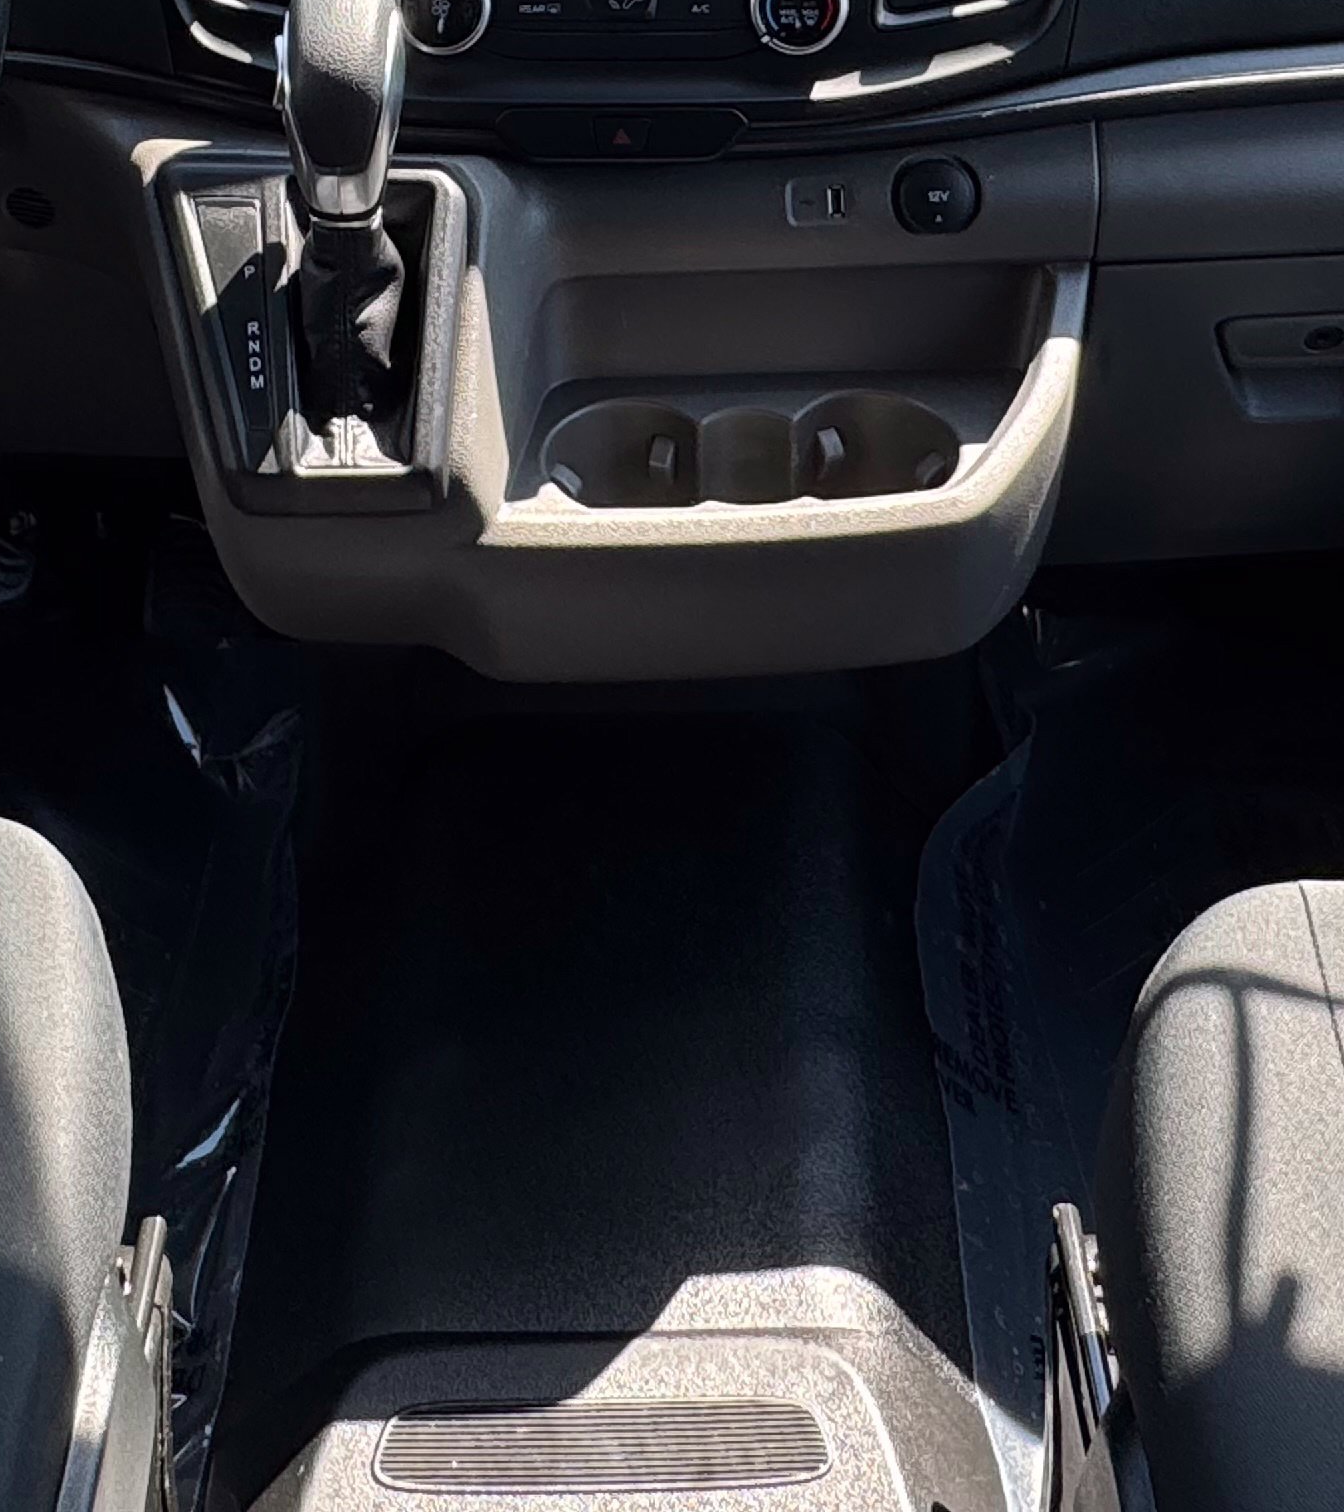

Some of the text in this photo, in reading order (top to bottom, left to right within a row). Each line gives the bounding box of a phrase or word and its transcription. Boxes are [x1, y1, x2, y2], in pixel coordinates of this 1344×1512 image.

[927, 190, 950, 203] 12V
[244, 265, 256, 279] P
[247, 322, 261, 335] R
[249, 341, 261, 353] N
[250, 357, 262, 371] D
[250, 374, 264, 389] M
